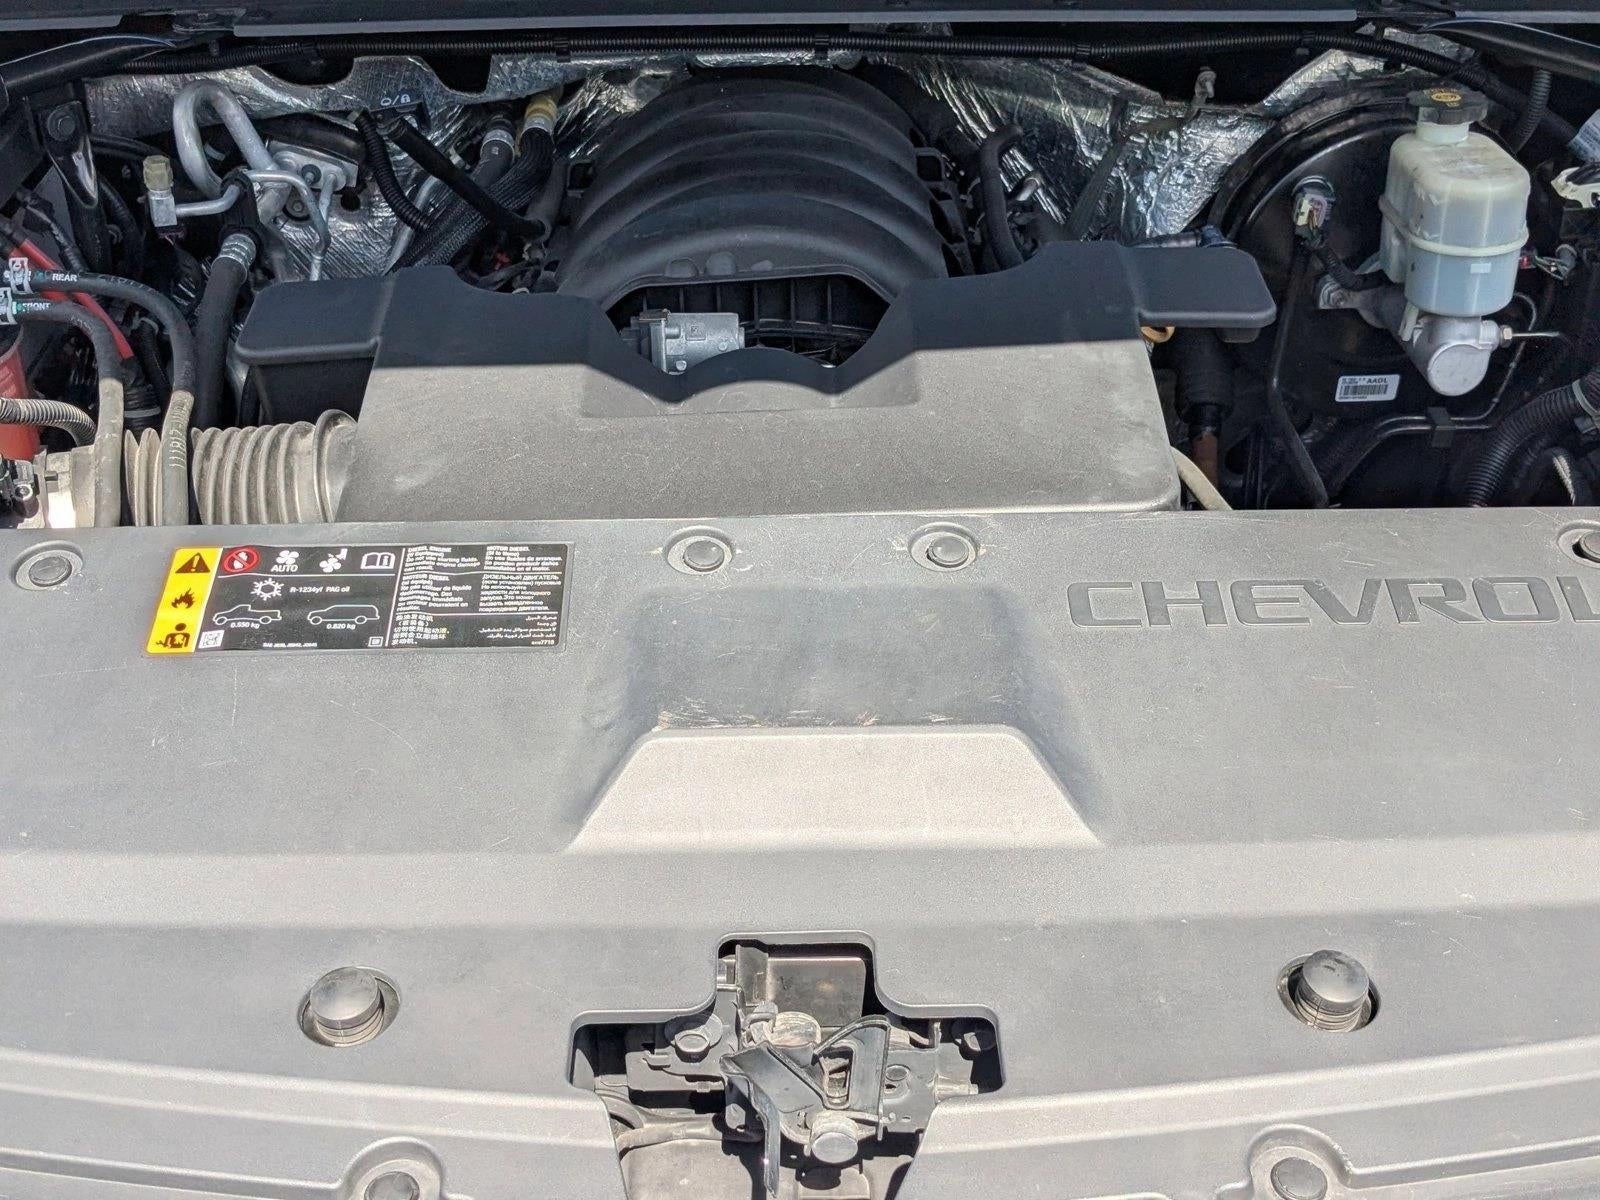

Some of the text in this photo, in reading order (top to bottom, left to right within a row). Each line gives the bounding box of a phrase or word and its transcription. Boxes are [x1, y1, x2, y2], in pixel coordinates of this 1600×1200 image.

[52, 273, 78, 282] REAR
[271, 564, 299, 573] AUTO
[346, 622, 356, 630] kg
